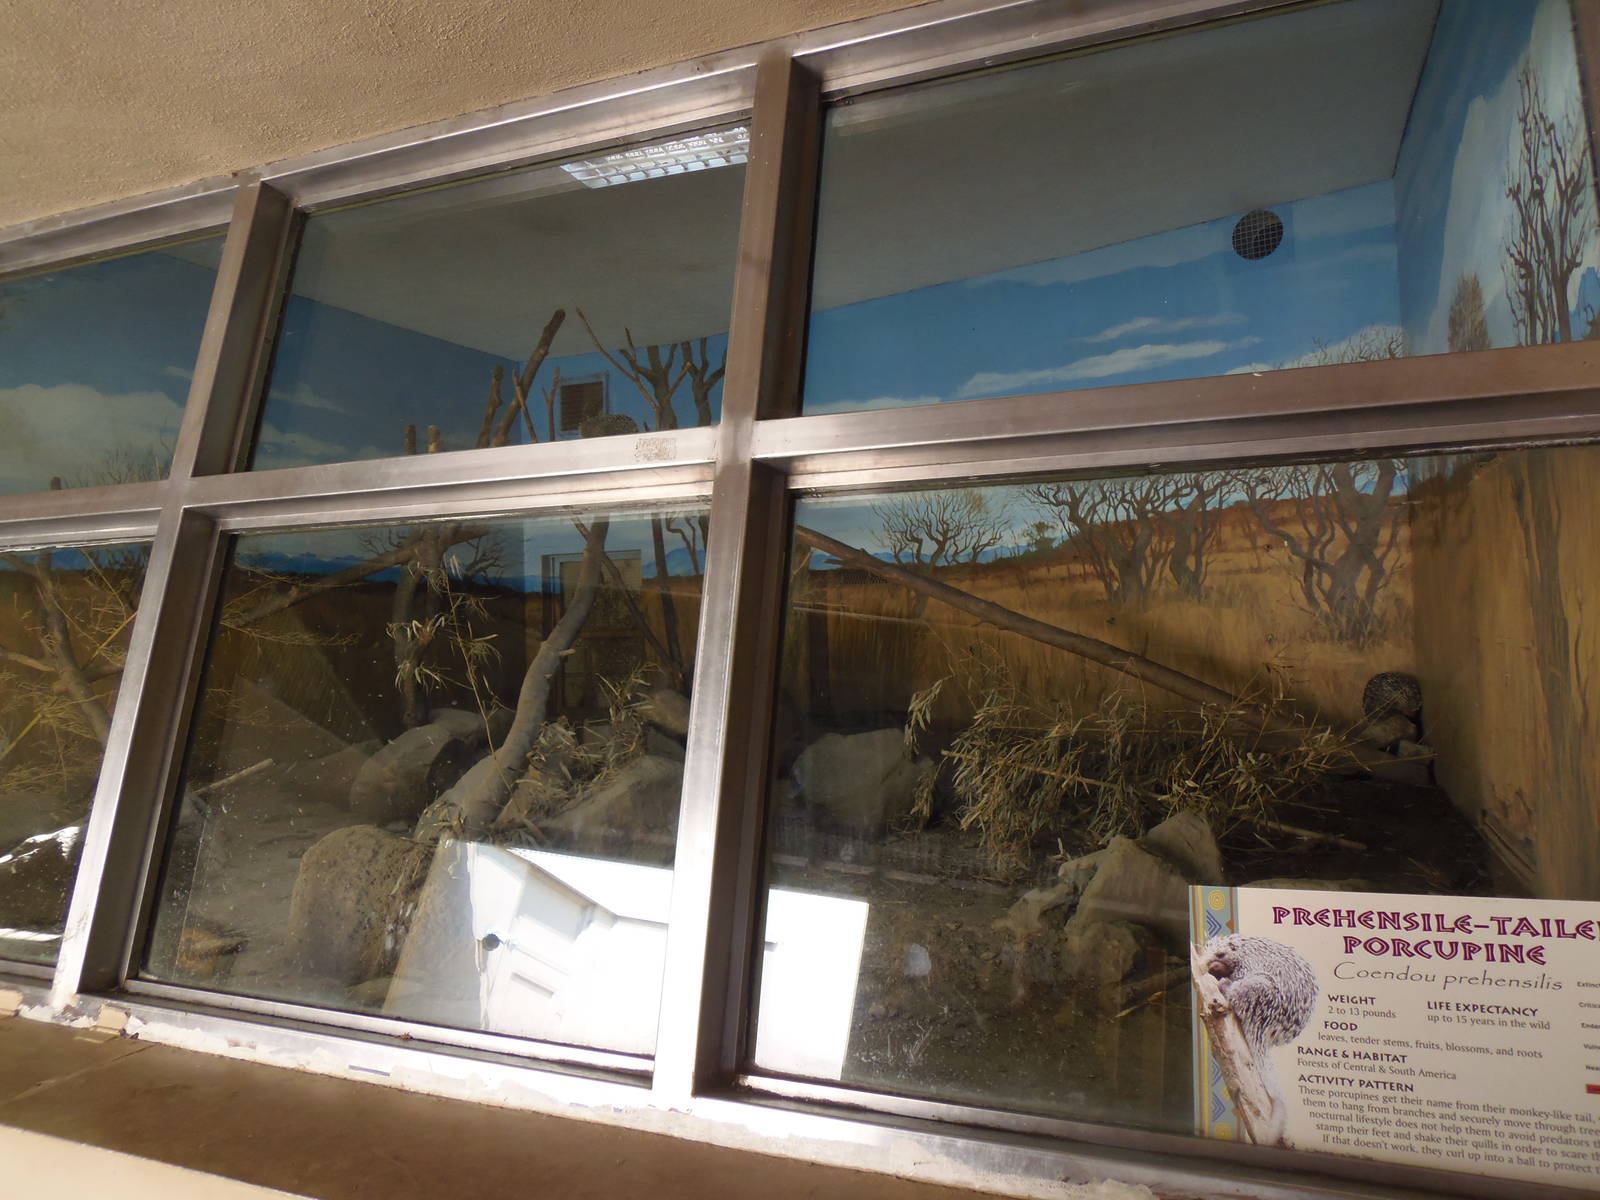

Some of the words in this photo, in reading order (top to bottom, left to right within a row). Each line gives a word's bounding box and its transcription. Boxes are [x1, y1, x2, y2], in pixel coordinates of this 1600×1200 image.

[1272, 906, 1600, 942] PREHENSILE-TAILE
[1343, 936, 1547, 965] PORCUPINE
[1334, 961, 1436, 983] Coendou
[1443, 970, 1562, 990] prehensilis
[1328, 994, 1376, 1005] WEIGHT
[1328, 1006, 1333, 1014] 2
[1335, 1007, 1346, 1015] to
[1350, 1007, 1360, 1016] 13
[1363, 1008, 1396, 1018] pounds
[1427, 1001, 1451, 1011] LIFE
[1456, 1002, 1538, 1017] EXPECTANCY
[1324, 1021, 1358, 1031] FOOD
[1427, 1015, 1439, 1023] up
[1442, 1015, 1452, 1023] to
[1456, 1015, 1467, 1024] 15
[1470, 1018, 1495, 1028] years
[1499, 1018, 1507, 1027] in
[1511, 1019, 1527, 1029] the
[1529, 1020, 1550, 1030] wild
[1297, 1047, 1338, 1058] RANGE
[1341, 1050, 1349, 1058] &
[1353, 1050, 1408, 1063] HABITAT
[1318, 1032, 1347, 1043] leaves,
[1350, 1036, 1380, 1045] tender
[1383, 1039, 1413, 1048] stems,
[1415, 1040, 1443, 1051] fruits,
[1446, 1042, 1493, 1055] blossoms,
[1496, 1048, 1514, 1056] and
[1517, 1050, 1543, 1058] roots
[1297, 1058, 1329, 1068] Forests
[1331, 1061, 1341, 1069] of
[1344, 1062, 1376, 1073] Central
[1378, 1065, 1386, 1074] &
[1389, 1066, 1416, 1076] South
[1418, 1069, 1457, 1080] America
[1298, 1074, 1355, 1087] ACTIVITY
[1359, 1079, 1414, 1092] PATTERN
[1298, 1085, 1325, 1096] These
[1329, 1089, 1379, 1101] porcupines
[1382, 1094, 1397, 1104] get
[1401, 1095, 1422, 1105] their
[1426, 1099, 1452, 1108] name
[1456, 1100, 1479, 1111] from
[1482, 1103, 1506, 1114] their
[1509, 1106, 1571, 1121] monkey-like
[1303, 1098, 1326, 1108] them
[1329, 1101, 1339, 1109] to
[1342, 1101, 1364, 1113] hang
[1367, 1104, 1390, 1114] from
[1392, 1106, 1435, 1119] branches
[1438, 1111, 1456, 1121] and
[1460, 1113, 1500, 1127] securely
[1504, 1118, 1531, 1129] move
[1534, 1121, 1576, 1135] through
[1309, 1110, 1353, 1122] nocturnal
[1356, 1114, 1392, 1127] lifestyle
[1395, 1118, 1418, 1129] does
[1421, 1122, 1437, 1131] not
[1441, 1123, 1462, 1134] help
[1465, 1126, 1491, 1137] them
[1494, 1129, 1504, 1138] to
[1508, 1131, 1536, 1142] avoid
[1540, 1134, 1590, 1147] predators
[1316, 1123, 1344, 1134] stamp
[1347, 1124, 1369, 1135] their
[1372, 1127, 1390, 1138] feet
[1393, 1131, 1411, 1141] and
[1414, 1132, 1442, 1144] shake
[1445, 1135, 1467, 1146] their
[1472, 1138, 1499, 1150] quills
[1502, 1142, 1511, 1151] in
[1515, 1144, 1541, 1154] order
[1546, 1147, 1558, 1156] to
[1322, 1134, 1330, 1143] If
[1332, 1135, 1351, 1145] that
[1353, 1139, 1388, 1150] doesn't
[1421, 1145, 1442, 1157] they
[1446, 1149, 1465, 1159] curl
[1467, 1153, 1480, 1162] up
[1484, 1153, 1505, 1164] into
[1517, 1155, 1536, 1167] ball
[1539, 1159, 1550, 1168] to
[1554, 1161, 1592, 1174] protect
